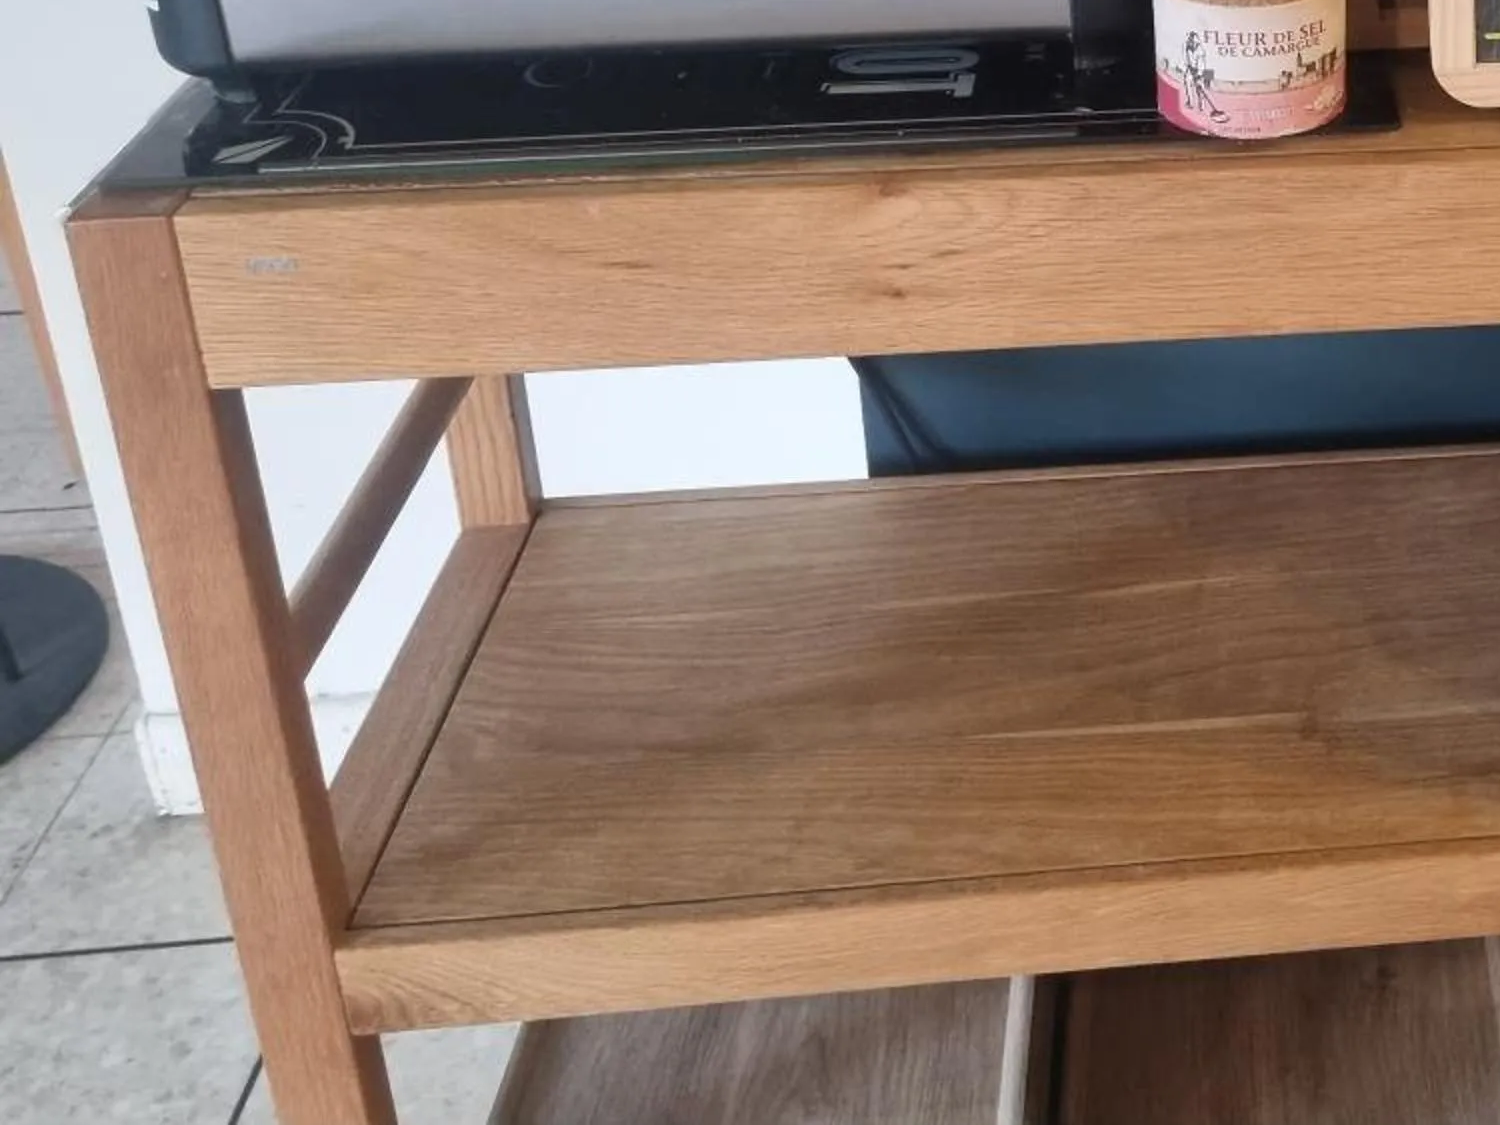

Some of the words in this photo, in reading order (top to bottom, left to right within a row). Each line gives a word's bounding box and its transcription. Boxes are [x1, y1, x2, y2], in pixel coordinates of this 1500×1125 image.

[1203, 30, 1267, 46] FLEUR
[1273, 31, 1295, 44] DE
[1299, 19, 1326, 37] SEL
[1217, 46, 1239, 57] DE
